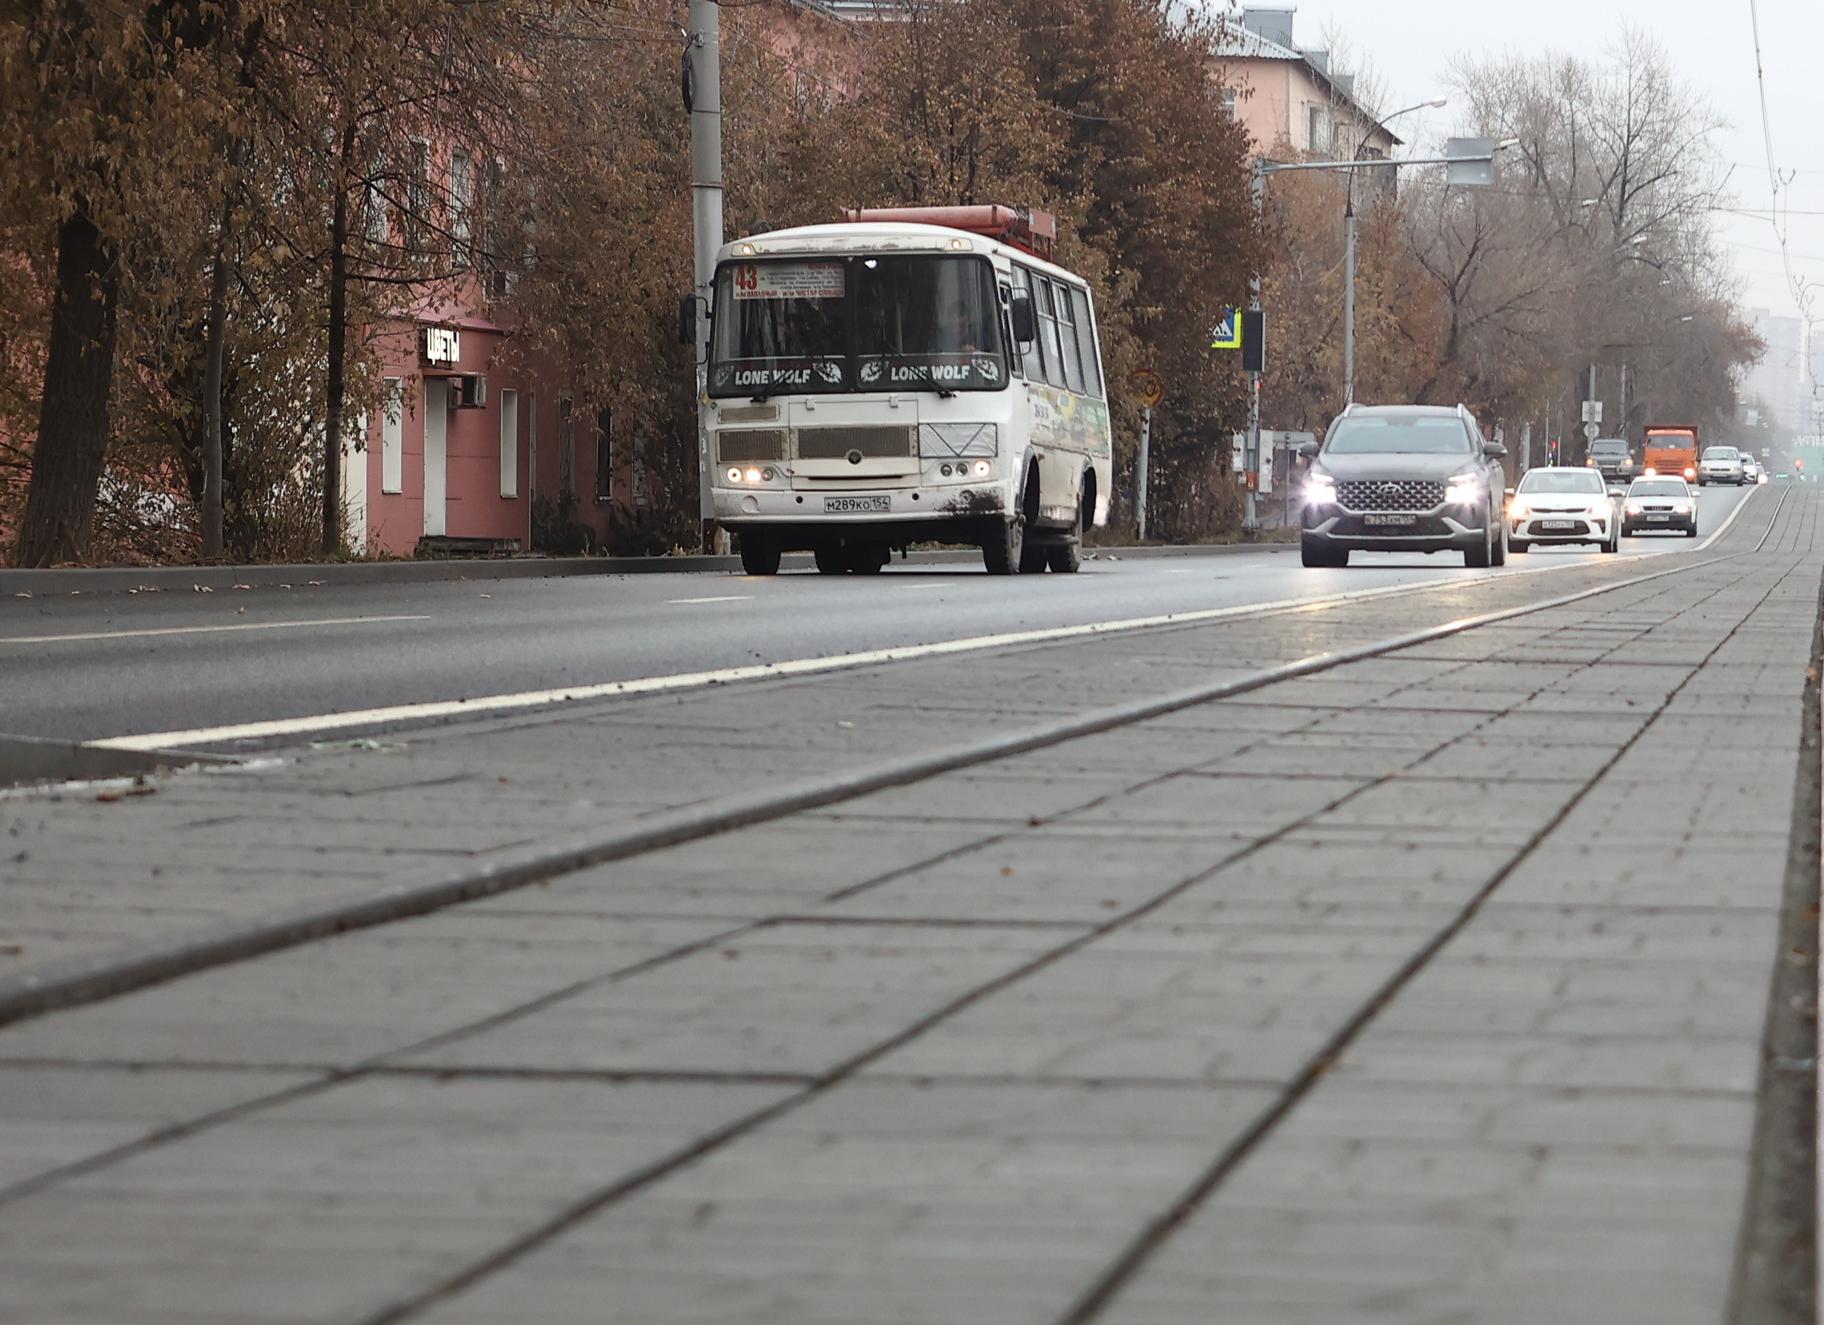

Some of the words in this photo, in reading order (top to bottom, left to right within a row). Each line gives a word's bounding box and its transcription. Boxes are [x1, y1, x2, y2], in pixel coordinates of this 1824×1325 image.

[736, 264, 757, 290] 43
[427, 327, 460, 366] ЦВЕТЫ
[735, 370, 769, 385] LONE
[773, 369, 811, 384] WOLF
[891, 366, 928, 381] LONE
[931, 365, 970, 380] WOLF
